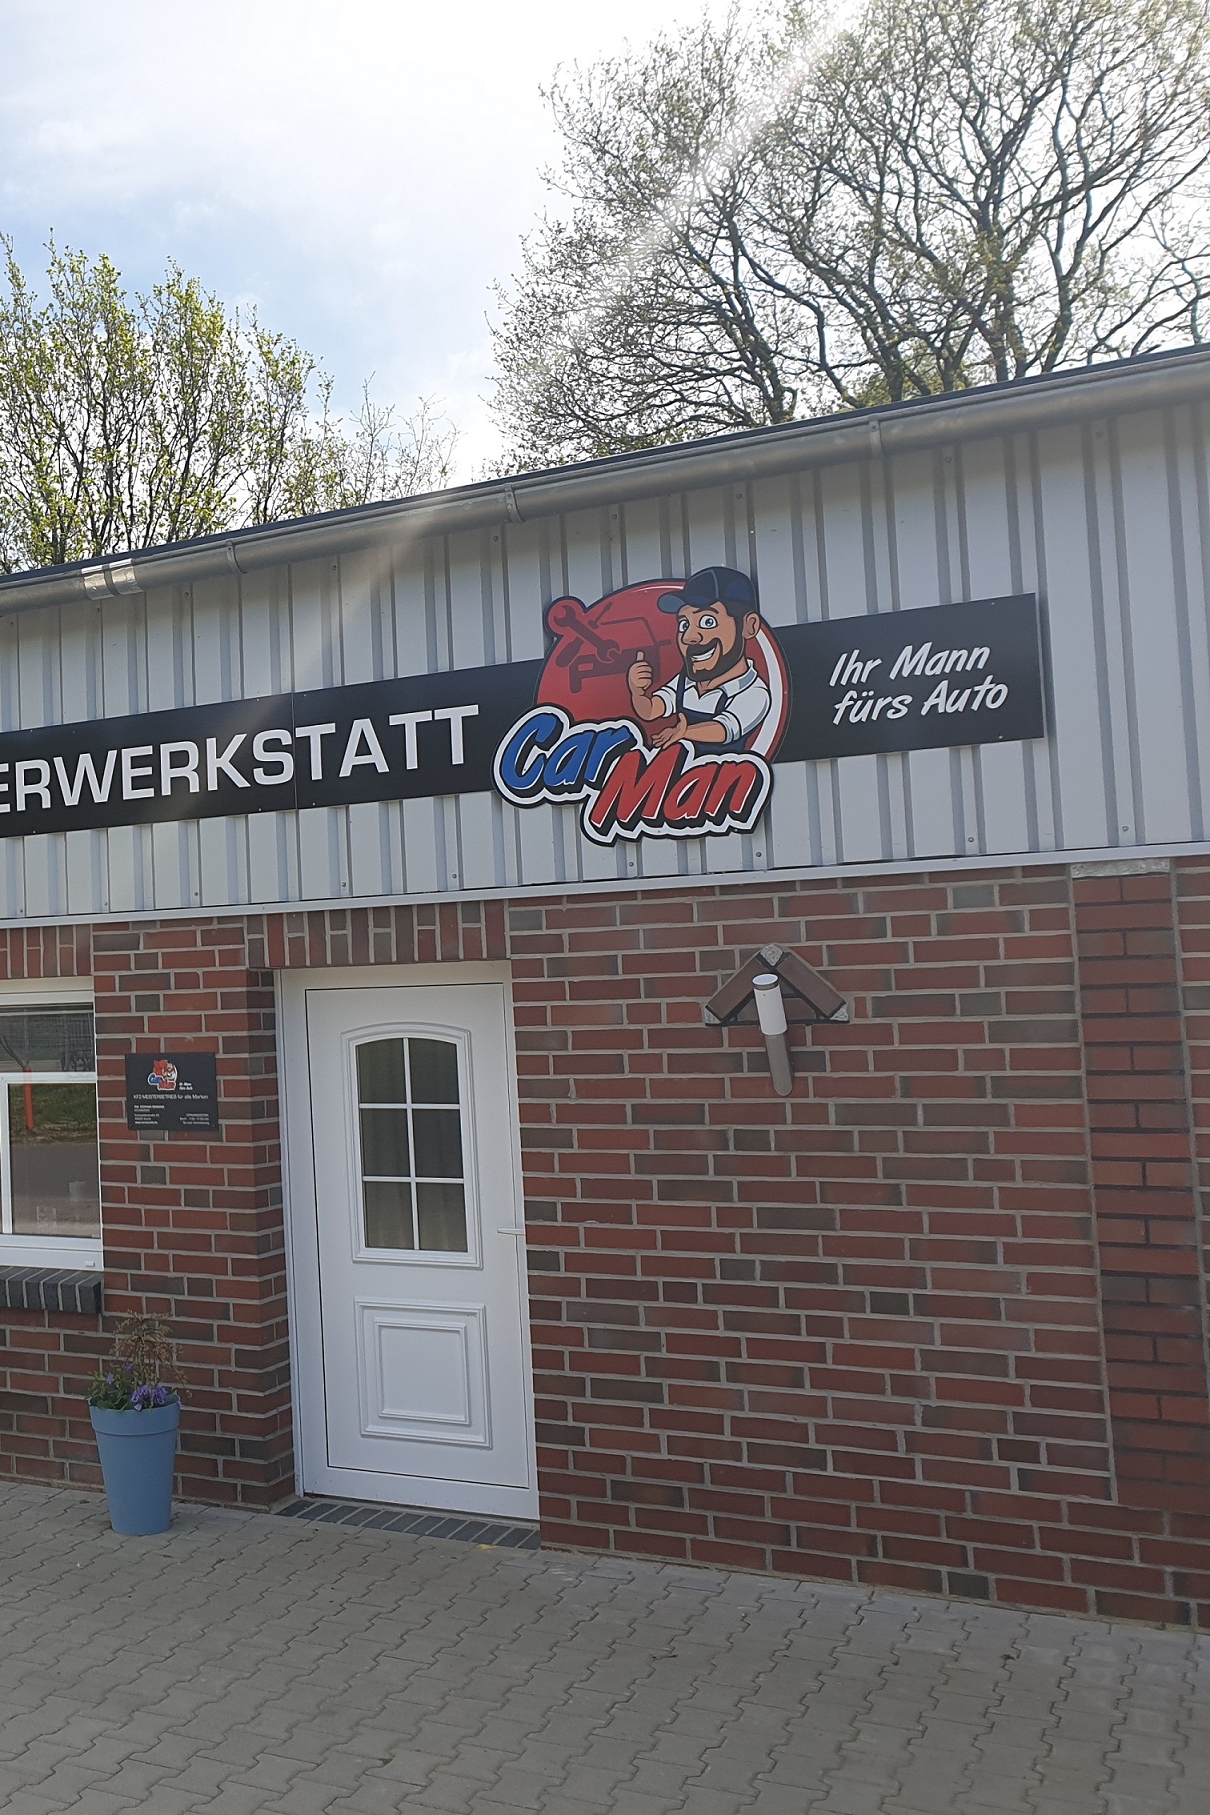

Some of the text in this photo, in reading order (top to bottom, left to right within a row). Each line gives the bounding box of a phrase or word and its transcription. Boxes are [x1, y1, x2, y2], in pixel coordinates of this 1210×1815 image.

[829, 641, 991, 687] Ihr Mann
[832, 674, 1009, 726] fürs Auto
[499, 711, 635, 791] Car
[589, 743, 760, 828] Man
